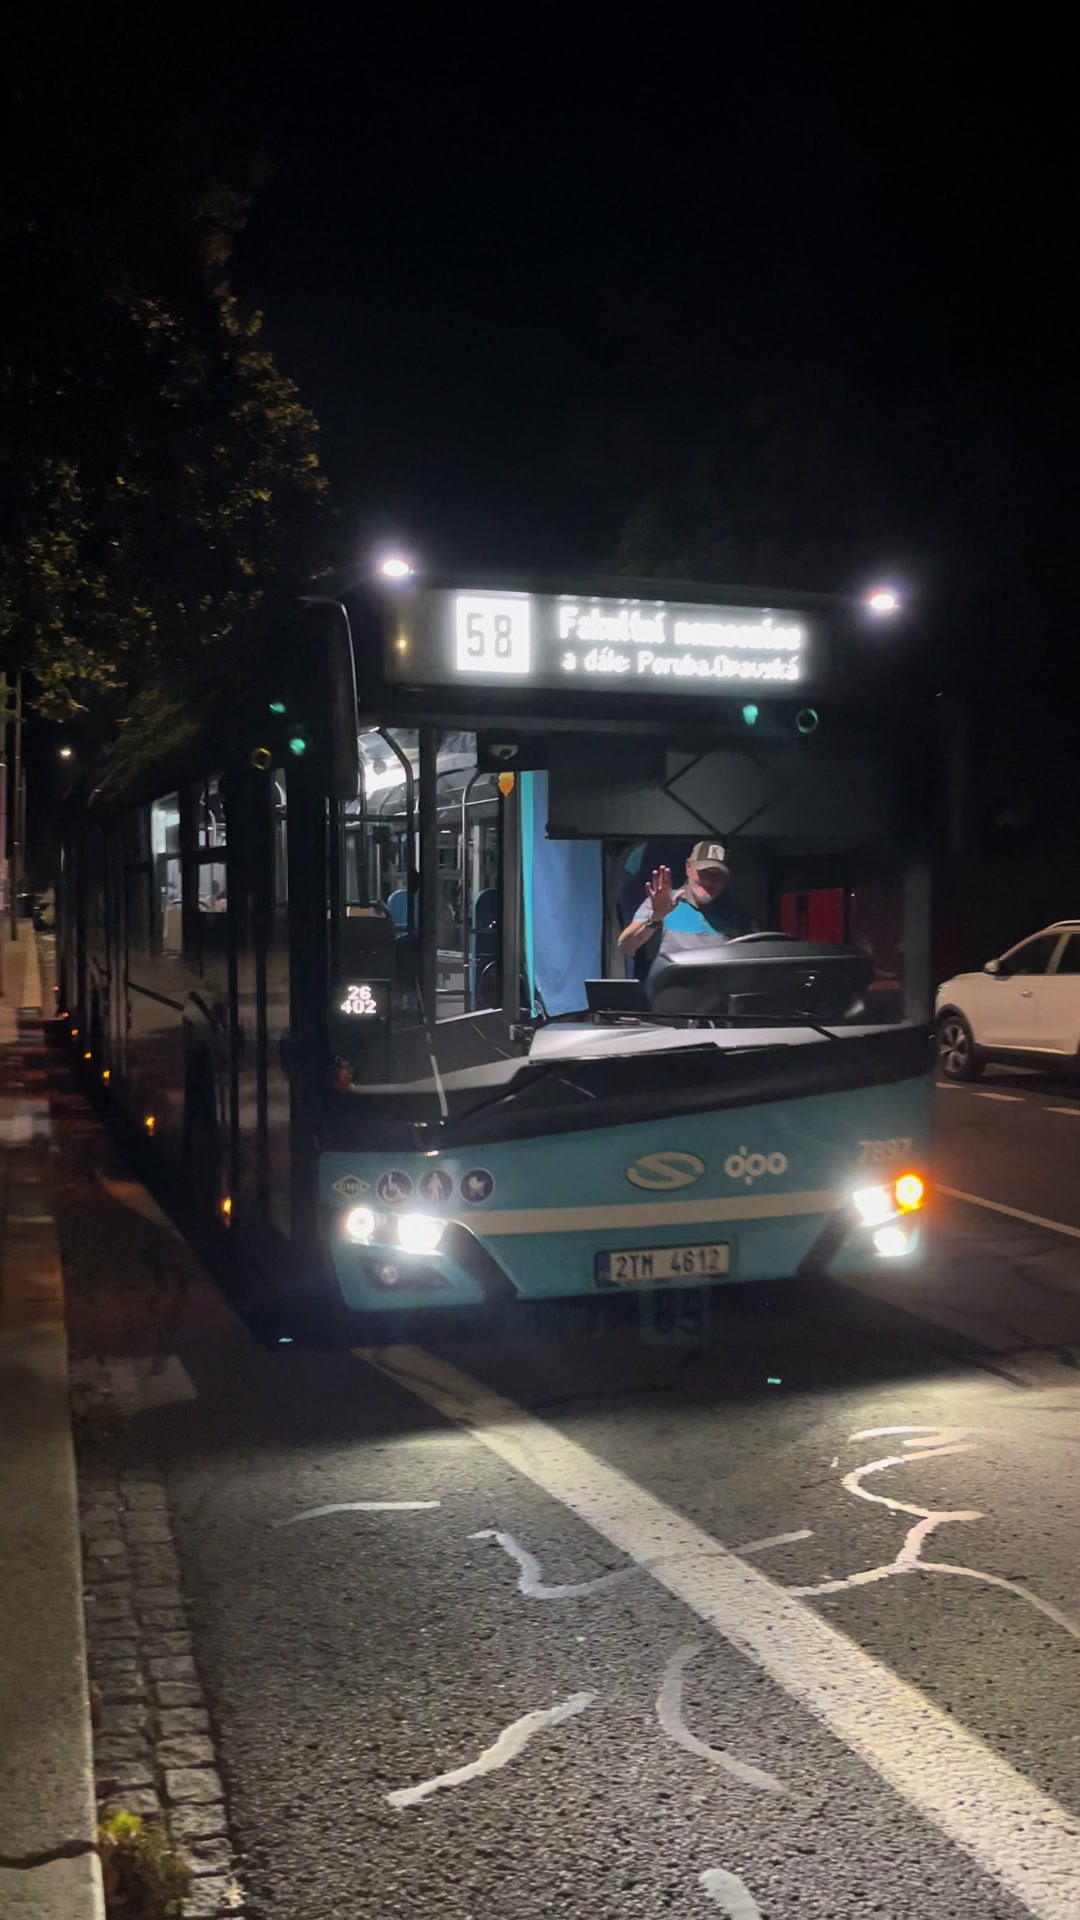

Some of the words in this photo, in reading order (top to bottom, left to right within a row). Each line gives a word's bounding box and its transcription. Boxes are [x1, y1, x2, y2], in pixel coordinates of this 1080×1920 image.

[466, 612, 513, 659] 58
[563, 653, 576, 670] a
[347, 985, 372, 1000] 26
[340, 1000, 377, 1014] 402
[616, 1253, 653, 1278] 2TM
[671, 1248, 720, 1272] 4612
